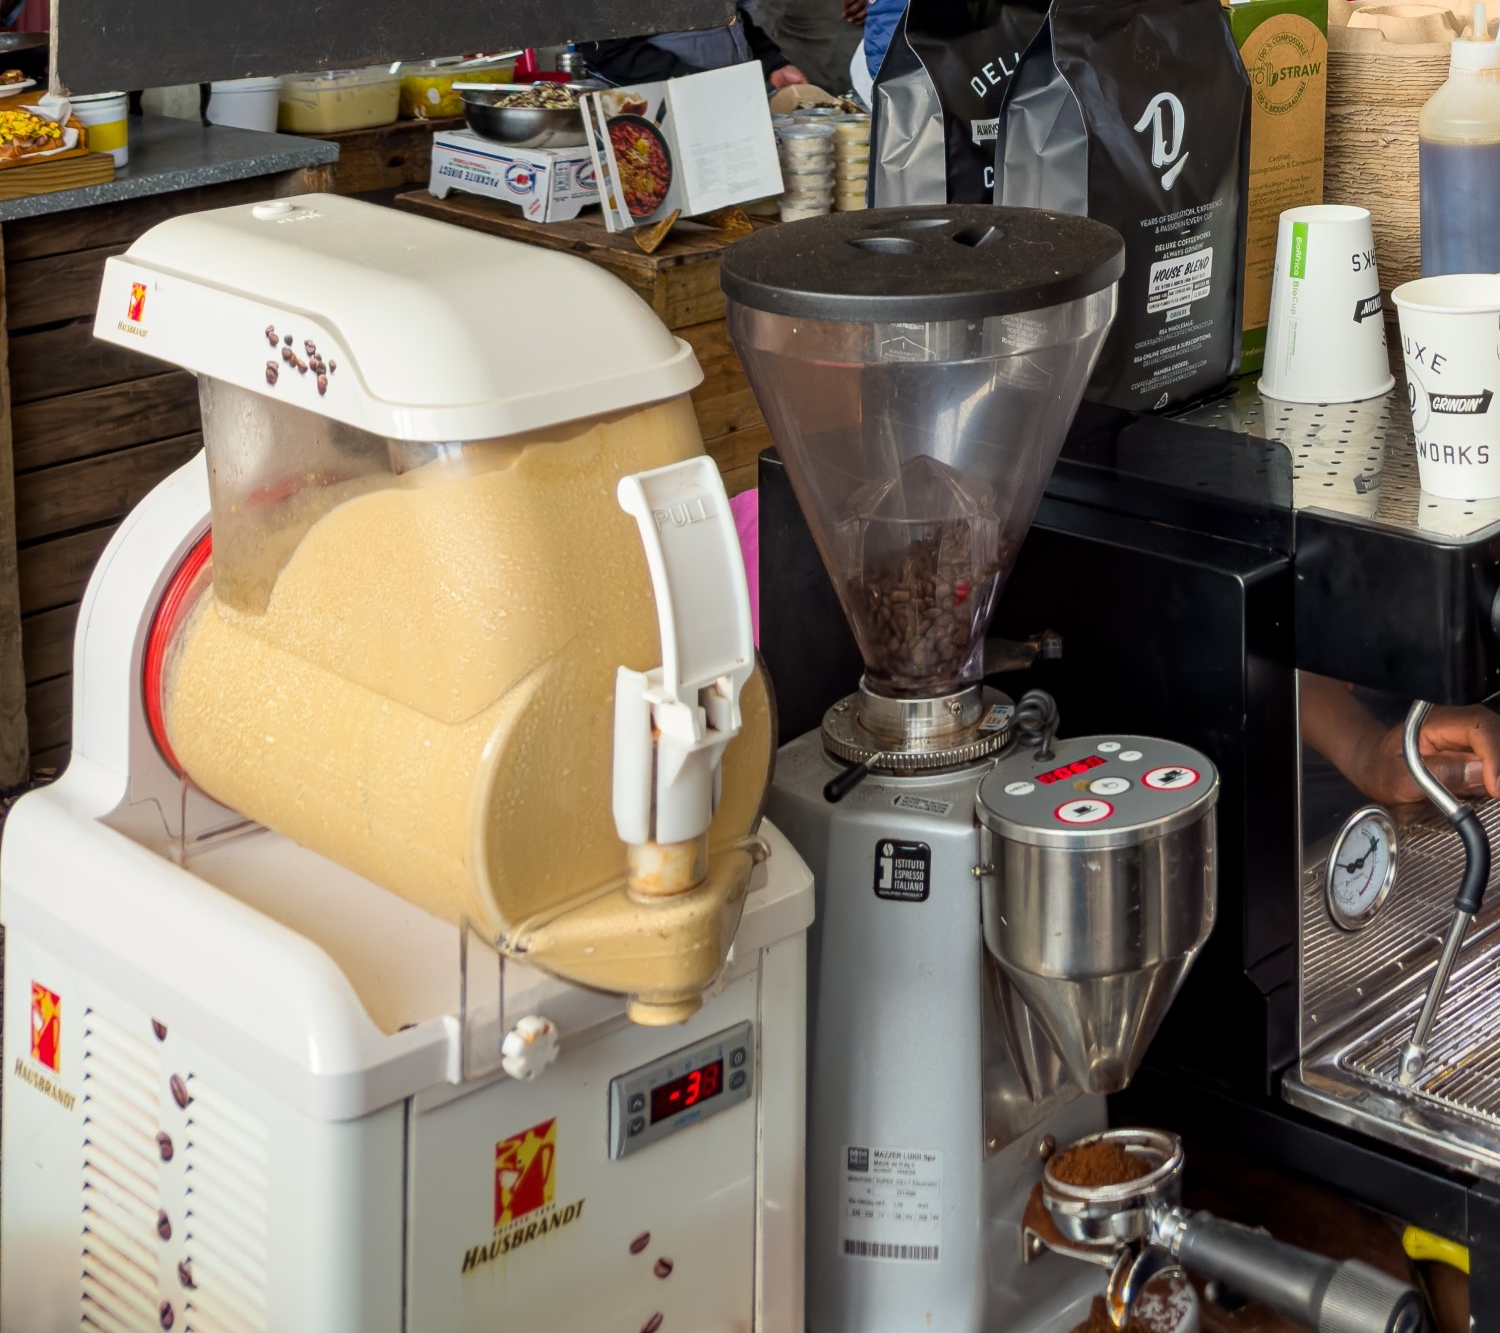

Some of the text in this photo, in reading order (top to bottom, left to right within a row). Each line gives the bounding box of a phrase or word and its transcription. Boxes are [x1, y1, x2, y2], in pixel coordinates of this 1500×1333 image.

[1280, 62, 1321, 81] STRAW
[1140, 216, 1159, 227] YEARS
[1186, 214, 1204, 226] EVERY
[1155, 241, 1177, 252] DELUXE
[1153, 255, 1210, 284] HOUSE BLEND
[1290, 280, 1300, 316] BioCup
[651, 498, 717, 533] PULL
[895, 858, 925, 870] ISTITUTO
[894, 870, 924, 881] ESPRESSO
[894, 880, 924, 891] ITALIANO
[14, 1056, 77, 1112] HAUSBRANDT
[461, 1197, 586, 1275] HAUSBRANDT
